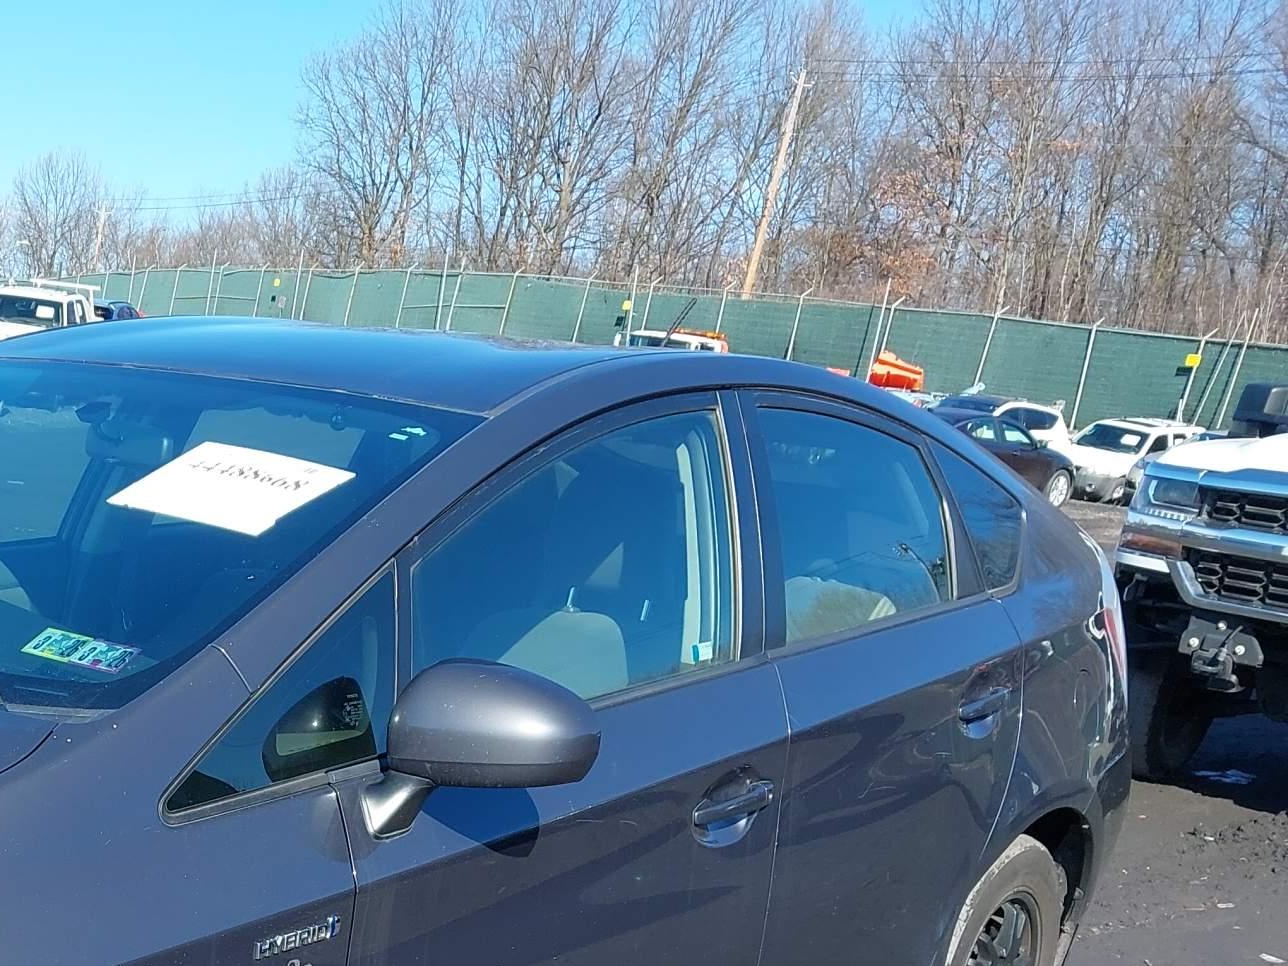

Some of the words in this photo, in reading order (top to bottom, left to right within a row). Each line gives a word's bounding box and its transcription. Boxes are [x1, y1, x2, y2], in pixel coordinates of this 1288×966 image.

[33, 635, 53, 650] 3
[78, 646, 98, 662] 3
[254, 917, 334, 960] HYBRID
